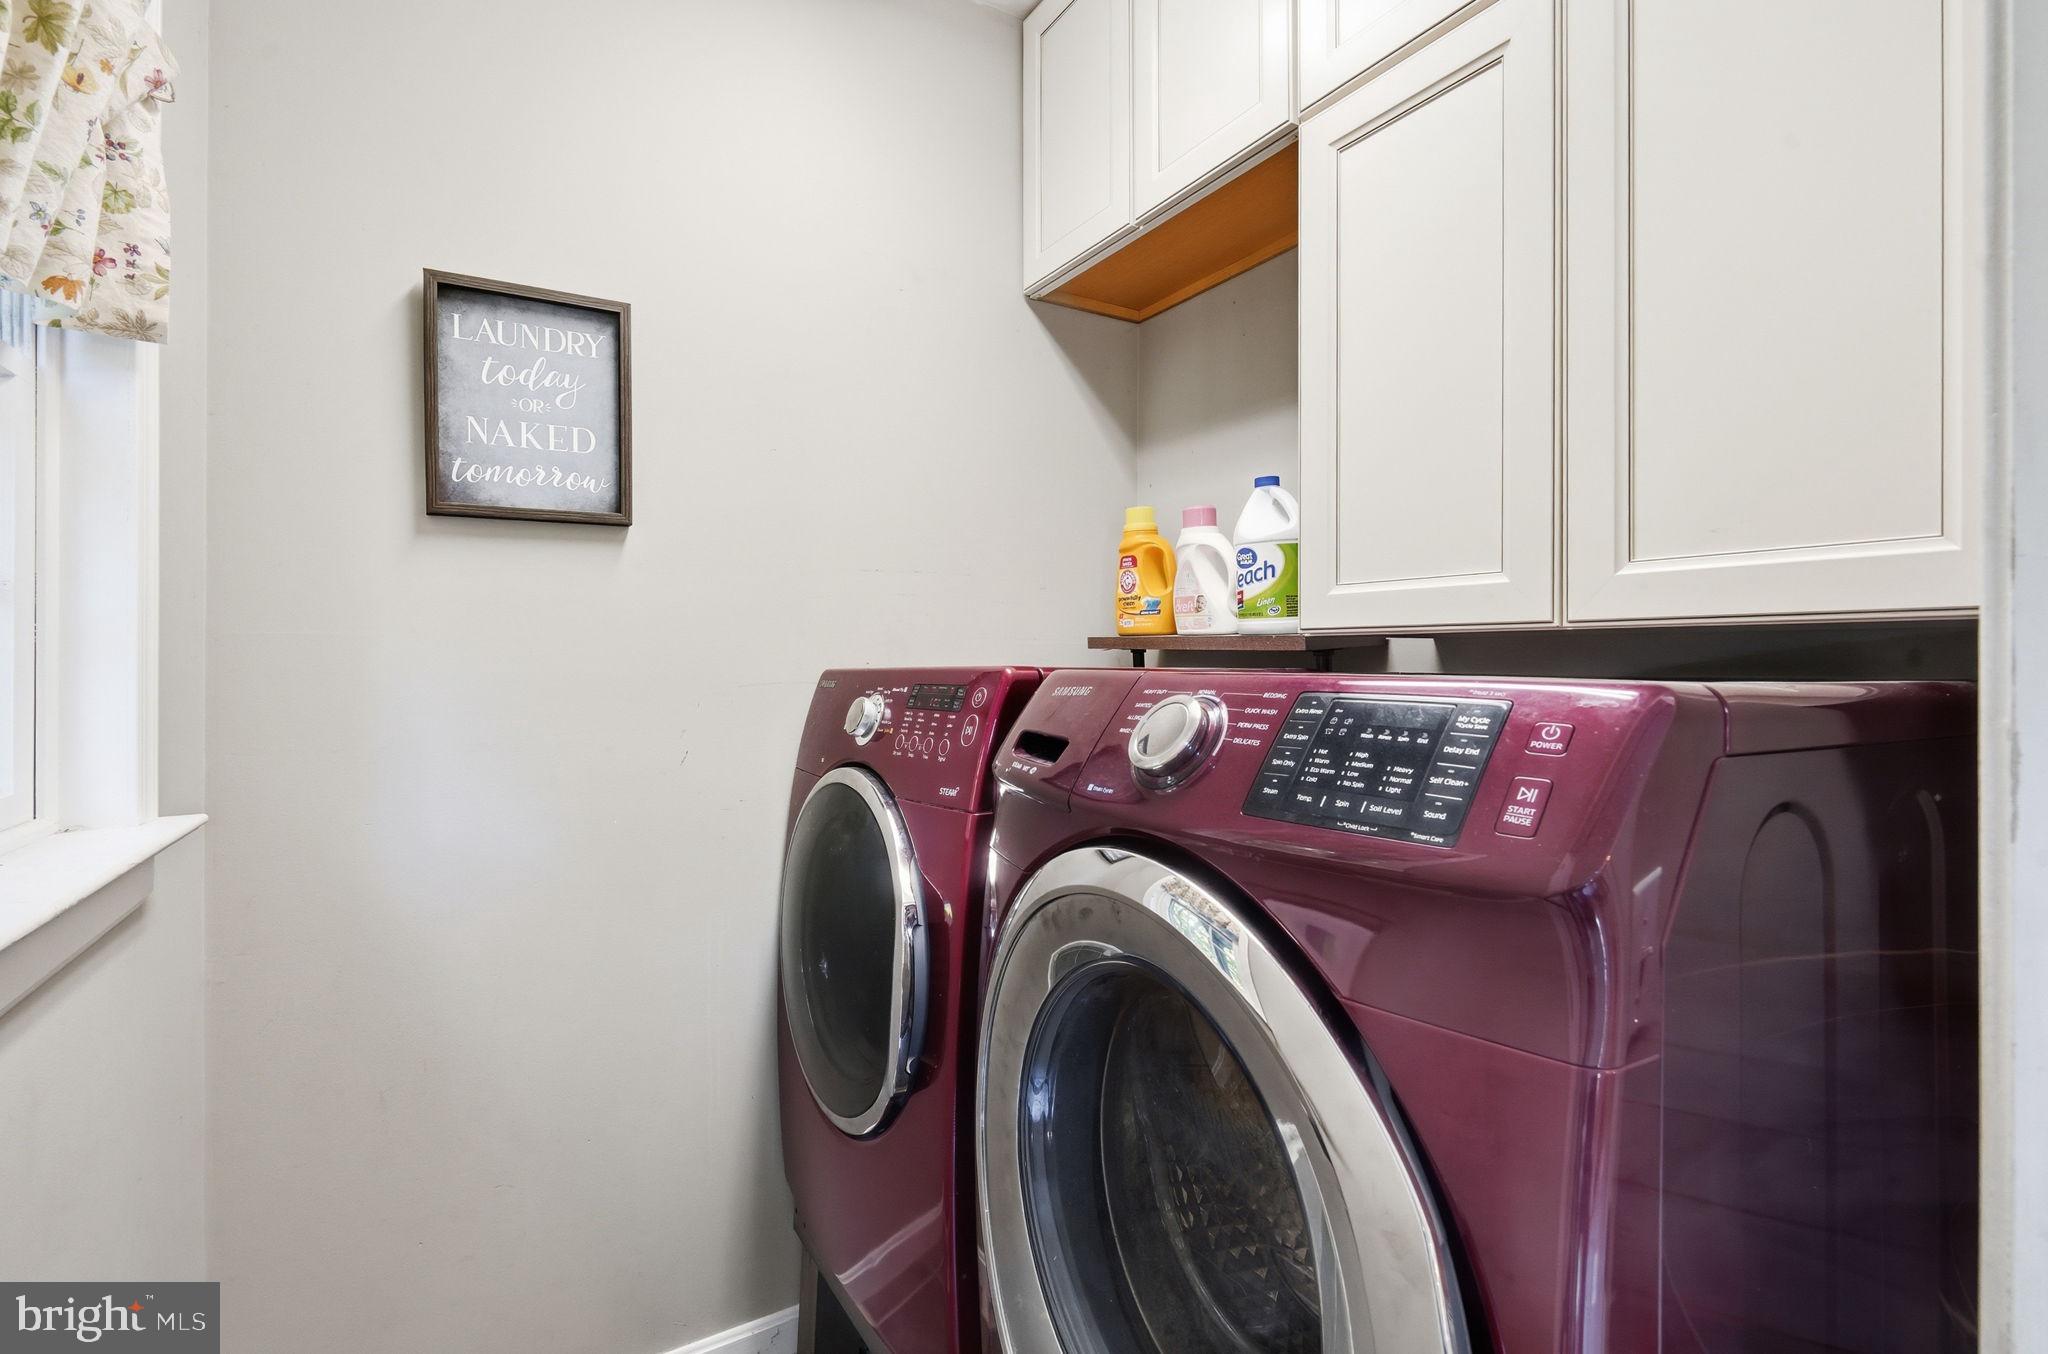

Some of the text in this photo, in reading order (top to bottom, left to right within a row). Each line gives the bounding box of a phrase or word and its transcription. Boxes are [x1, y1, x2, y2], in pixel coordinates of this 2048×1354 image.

[451, 313, 606, 358] LAUNDRY
[481, 356, 586, 410] today
[518, 398, 545, 414] OR
[465, 415, 597, 454] NAKED
[451, 456, 611, 493] tomorrow
[1236, 560, 1276, 588] each
[1052, 686, 1093, 696] SAMSUNG
[1470, 716, 1491, 724] Cycle
[1232, 738, 1261, 746] DELICATES
[1530, 740, 1563, 750] POWER
[1443, 746, 1480, 756] Delay End
[1282, 760, 1296, 768] Only
[1393, 766, 1414, 774] Heavy
[1389, 776, 1413, 785] Normal
[1429, 776, 1444, 784] Self
[1385, 786, 1402, 794] Light
[1334, 800, 1350, 808] Spin
[1369, 804, 1402, 816] Soil Level
[1423, 810, 1447, 820] Sound
[1507, 805, 1536, 815] START
[1503, 815, 1533, 826] PAUSE
